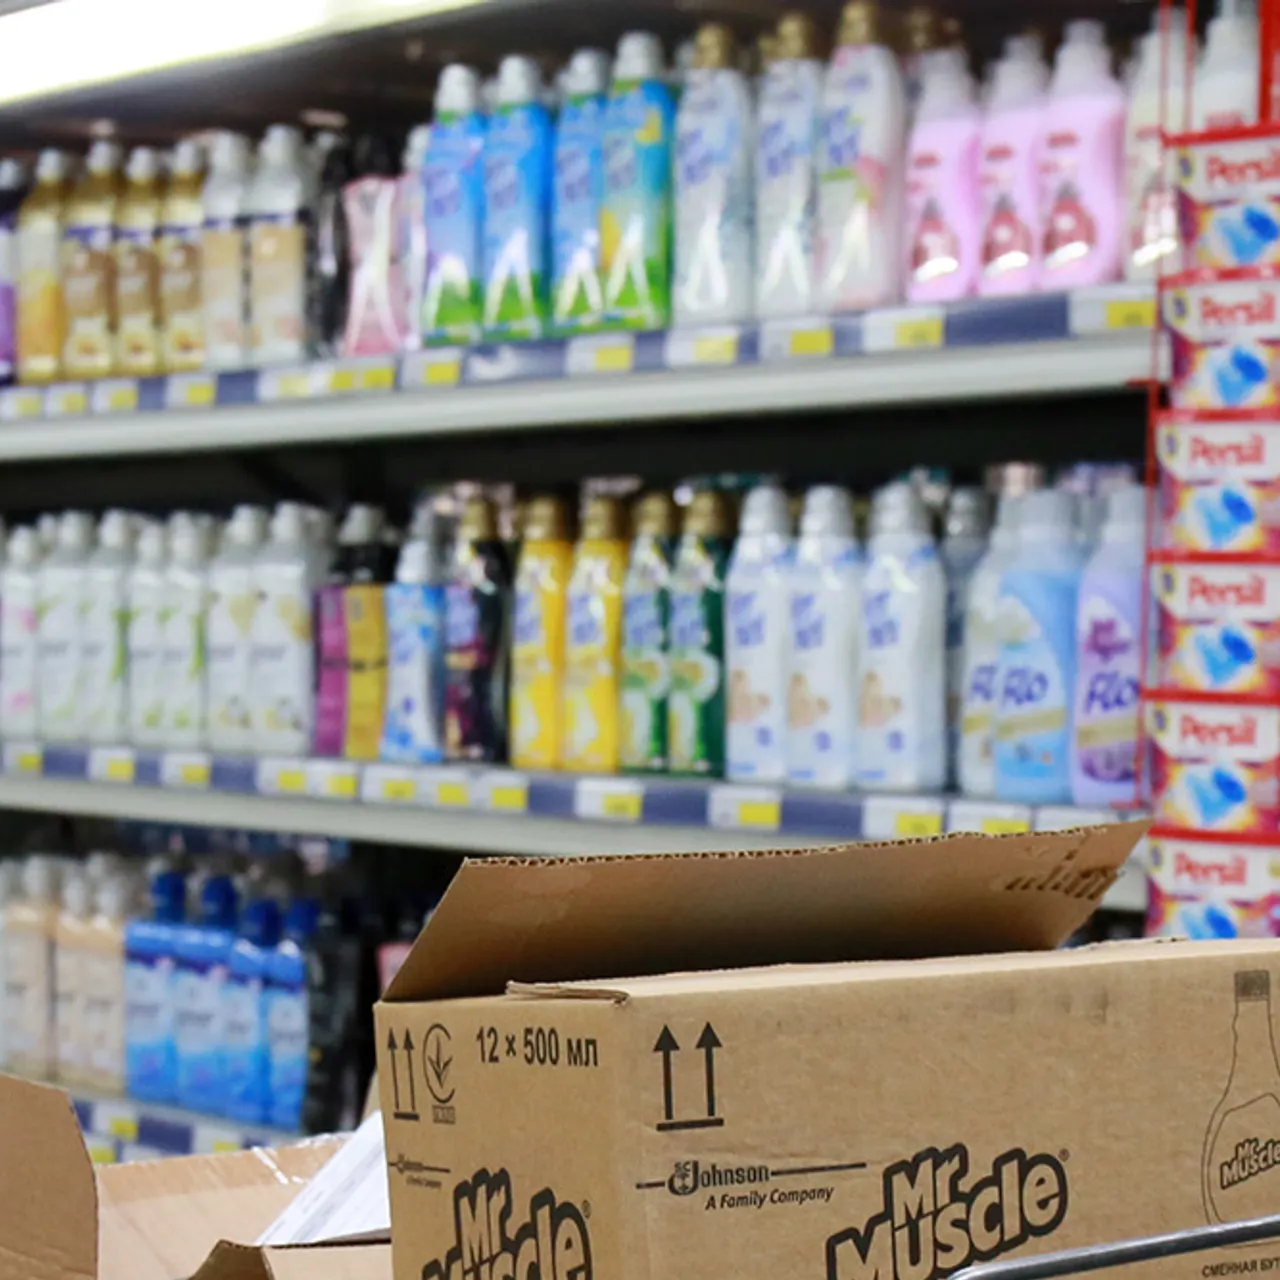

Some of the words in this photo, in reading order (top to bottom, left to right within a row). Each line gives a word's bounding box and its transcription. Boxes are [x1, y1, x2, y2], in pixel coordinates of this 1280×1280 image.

[1198, 288, 1276, 327] Persil
[1188, 433, 1266, 470] Persil
[1180, 714, 1258, 748] Persil
[1173, 851, 1247, 885] Persil
[477, 1027, 500, 1064] 12
[523, 1027, 560, 1067] 500
[704, 1195, 717, 1211] A
[719, 1192, 767, 1212] Family
[770, 1185, 835, 1207] Company
[883, 1142, 969, 1231] Mr
[453, 1167, 513, 1268] Mr
[1202, 1258, 1258, 1279] СМЕННАЯ
